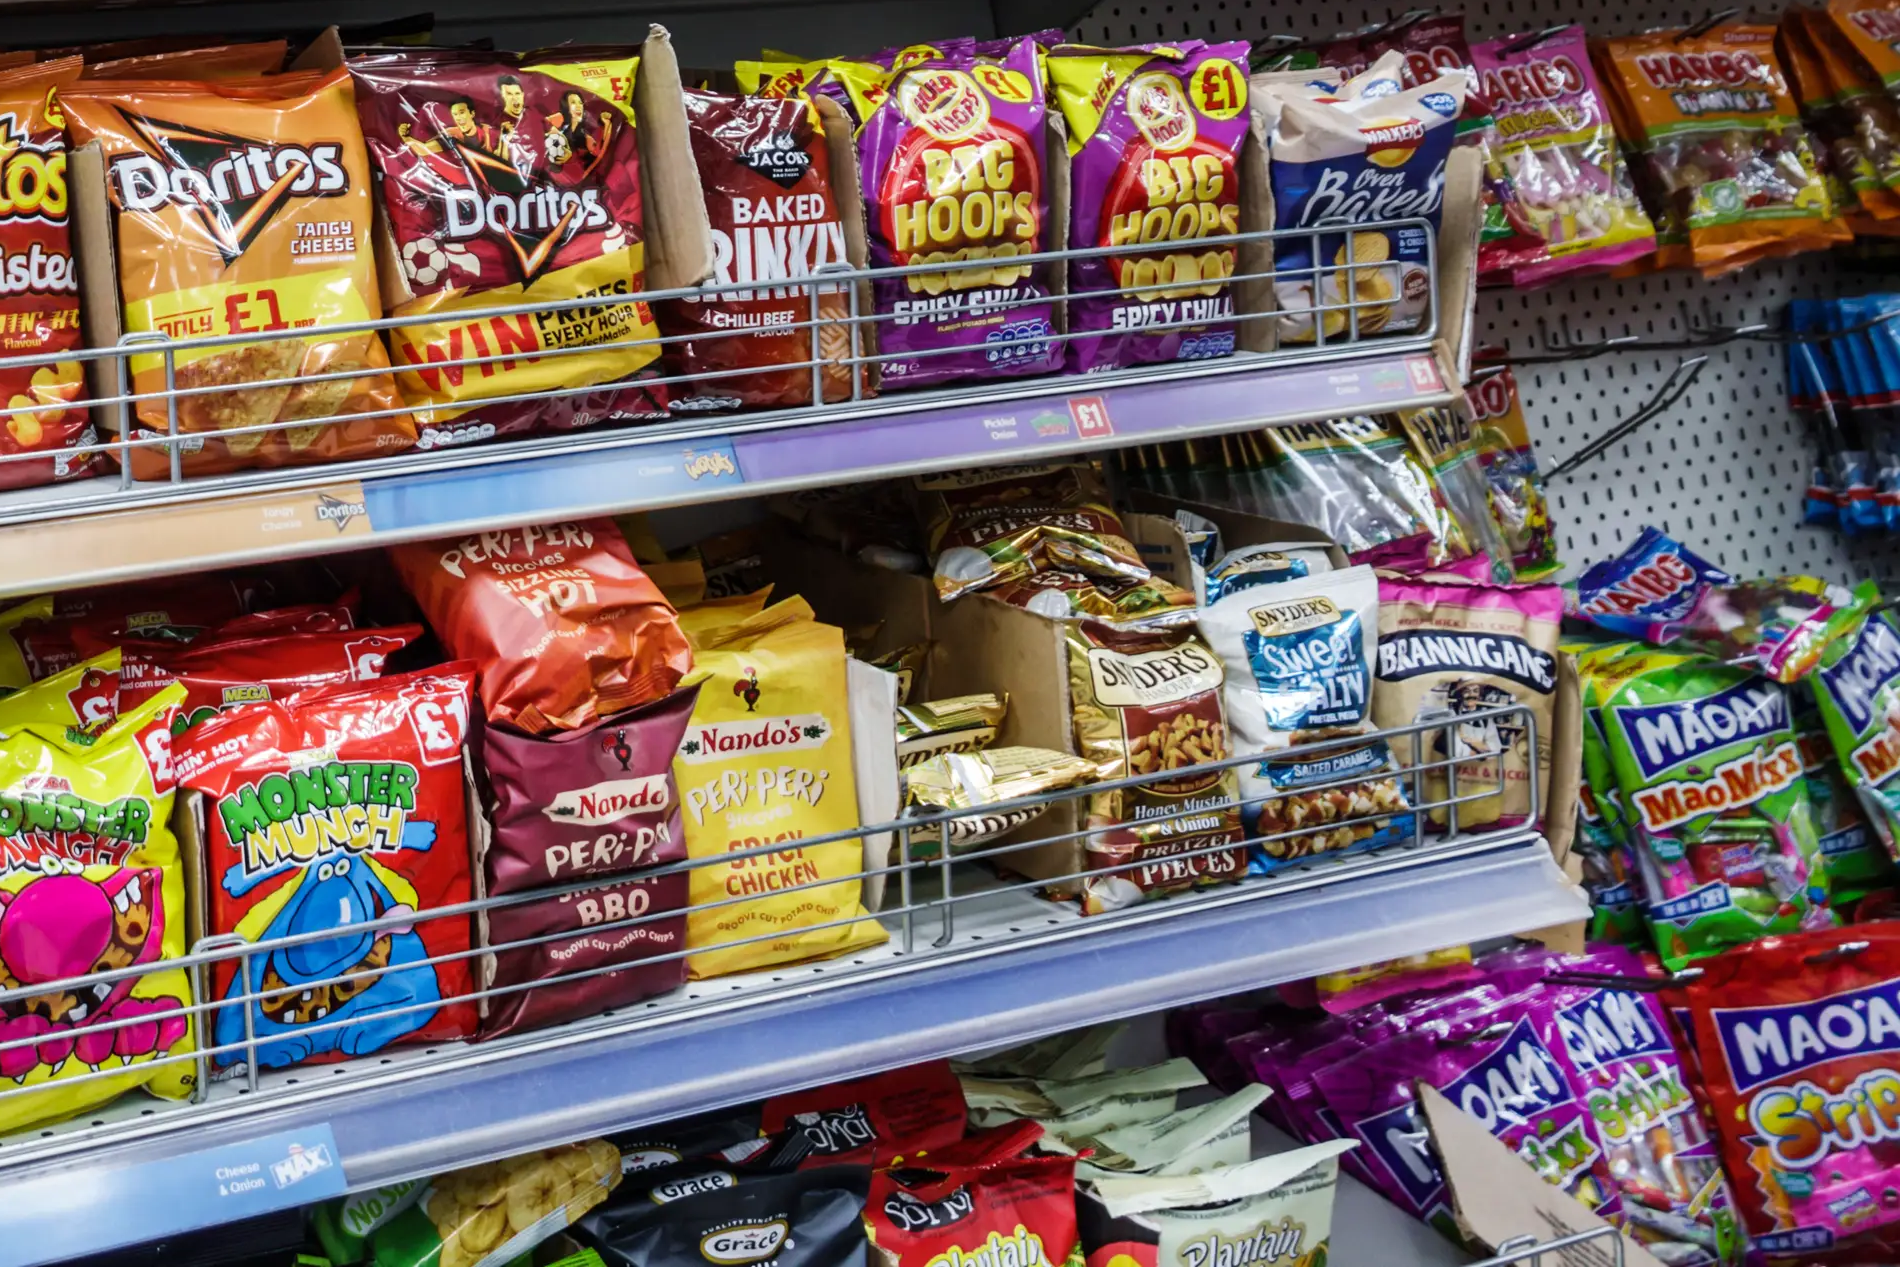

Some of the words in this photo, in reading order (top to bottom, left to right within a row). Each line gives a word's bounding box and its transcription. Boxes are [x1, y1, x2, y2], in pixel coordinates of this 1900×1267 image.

[580, 66, 608, 78] ONLY
[1201, 65, 1241, 112] £1
[114, 145, 348, 210] Doritos
[921, 139, 1016, 199] BIG
[1142, 154, 1226, 207] BIG
[1352, 167, 1407, 192] Oven
[444, 187, 609, 240] Doritos
[732, 193, 825, 224] BAKED
[893, 190, 1036, 253] HOOPS
[294, 221, 352, 238] TANGY
[1110, 202, 1241, 248] HOOPS
[290, 237, 355, 255] CHEESE
[224, 289, 283, 332] £1
[534, 278, 630, 332] PRIZES
[763, 309, 796, 325] BEEF
[893, 296, 968, 326] SPICY
[1112, 304, 1178, 331] SPICY
[542, 319, 595, 349] EVERY
[596, 304, 636, 331] HOUR
[3, 337, 43, 350] Flavour
[402, 308, 543, 392] WIN
[1077, 404, 1103, 431] £1
[317, 501, 365, 520] Doritos
[491, 551, 565, 575] grooves
[495, 568, 591, 595] SIZZLING
[517, 579, 599, 620] HOT
[1255, 598, 1335, 629] SNYDER'S
[1263, 636, 1357, 680] Sweet
[223, 685, 271, 703] MEGA
[414, 695, 468, 752] £1
[700, 719, 802, 756] Nando's
[1634, 680, 1787, 766] MAOAM
[212, 734, 250, 758] HOT
[1293, 761, 1332, 778] SALTED
[1332, 749, 1375, 772] CARAMEL
[1637, 742, 1802, 828] MaoMixx
[219, 760, 420, 846] MONSTER
[1133, 800, 1180, 821] Honey
[243, 803, 406, 874] MUNCH
[1160, 822, 1173, 836] &
[1175, 816, 1221, 835] Onion
[728, 829, 804, 871] SPICY
[725, 859, 820, 898] CHICKEN
[716, 911, 757, 931] GROOVE
[759, 911, 778, 925] CUT
[780, 902, 814, 924] POTATO
[550, 938, 590, 961] GROOVE
[591, 938, 611, 952] CUT
[612, 928, 647, 952] POTATO
[648, 929, 675, 943] CHIPS
[214, 1162, 260, 1181] Cheese
[275, 1147, 331, 1187] MAX
[229, 1173, 266, 1194] Onion
[659, 1172, 726, 1200] Grace
[713, 1229, 780, 1254] Grace
